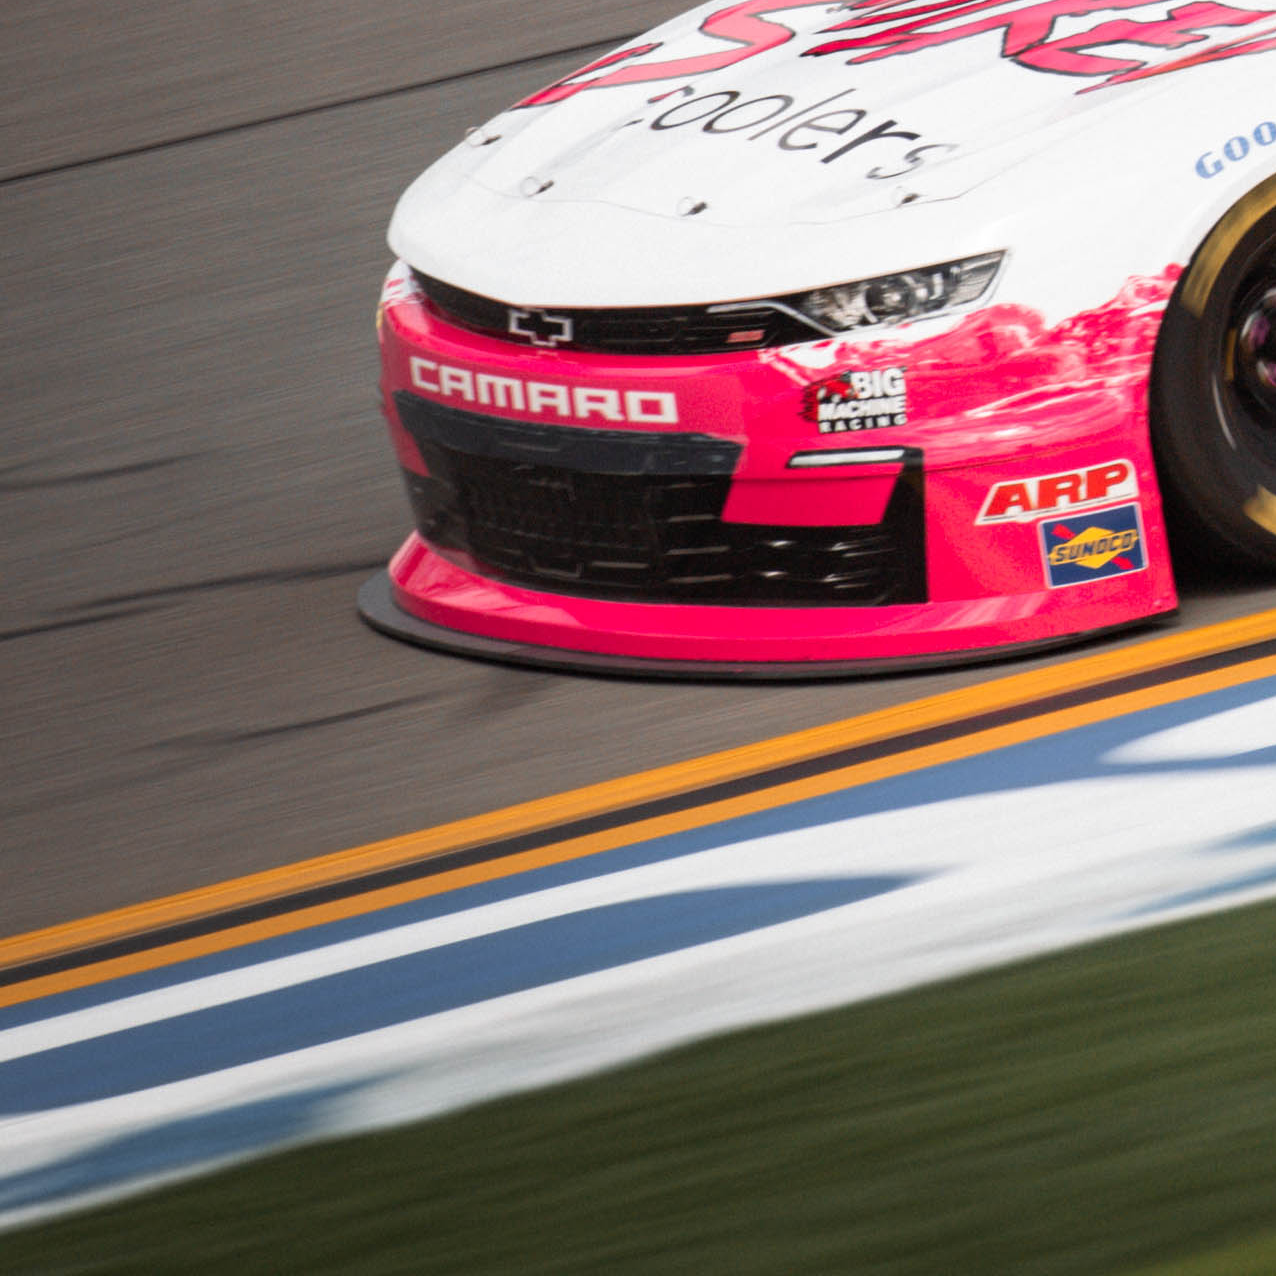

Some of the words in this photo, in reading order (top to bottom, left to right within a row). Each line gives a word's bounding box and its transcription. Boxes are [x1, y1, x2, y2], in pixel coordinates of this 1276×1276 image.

[409, 356, 679, 424] CAMARO
[851, 367, 906, 399] BIG
[819, 413, 907, 434] RACING
[985, 462, 1129, 516] ARP
[1055, 532, 1136, 564] SUNOCO
